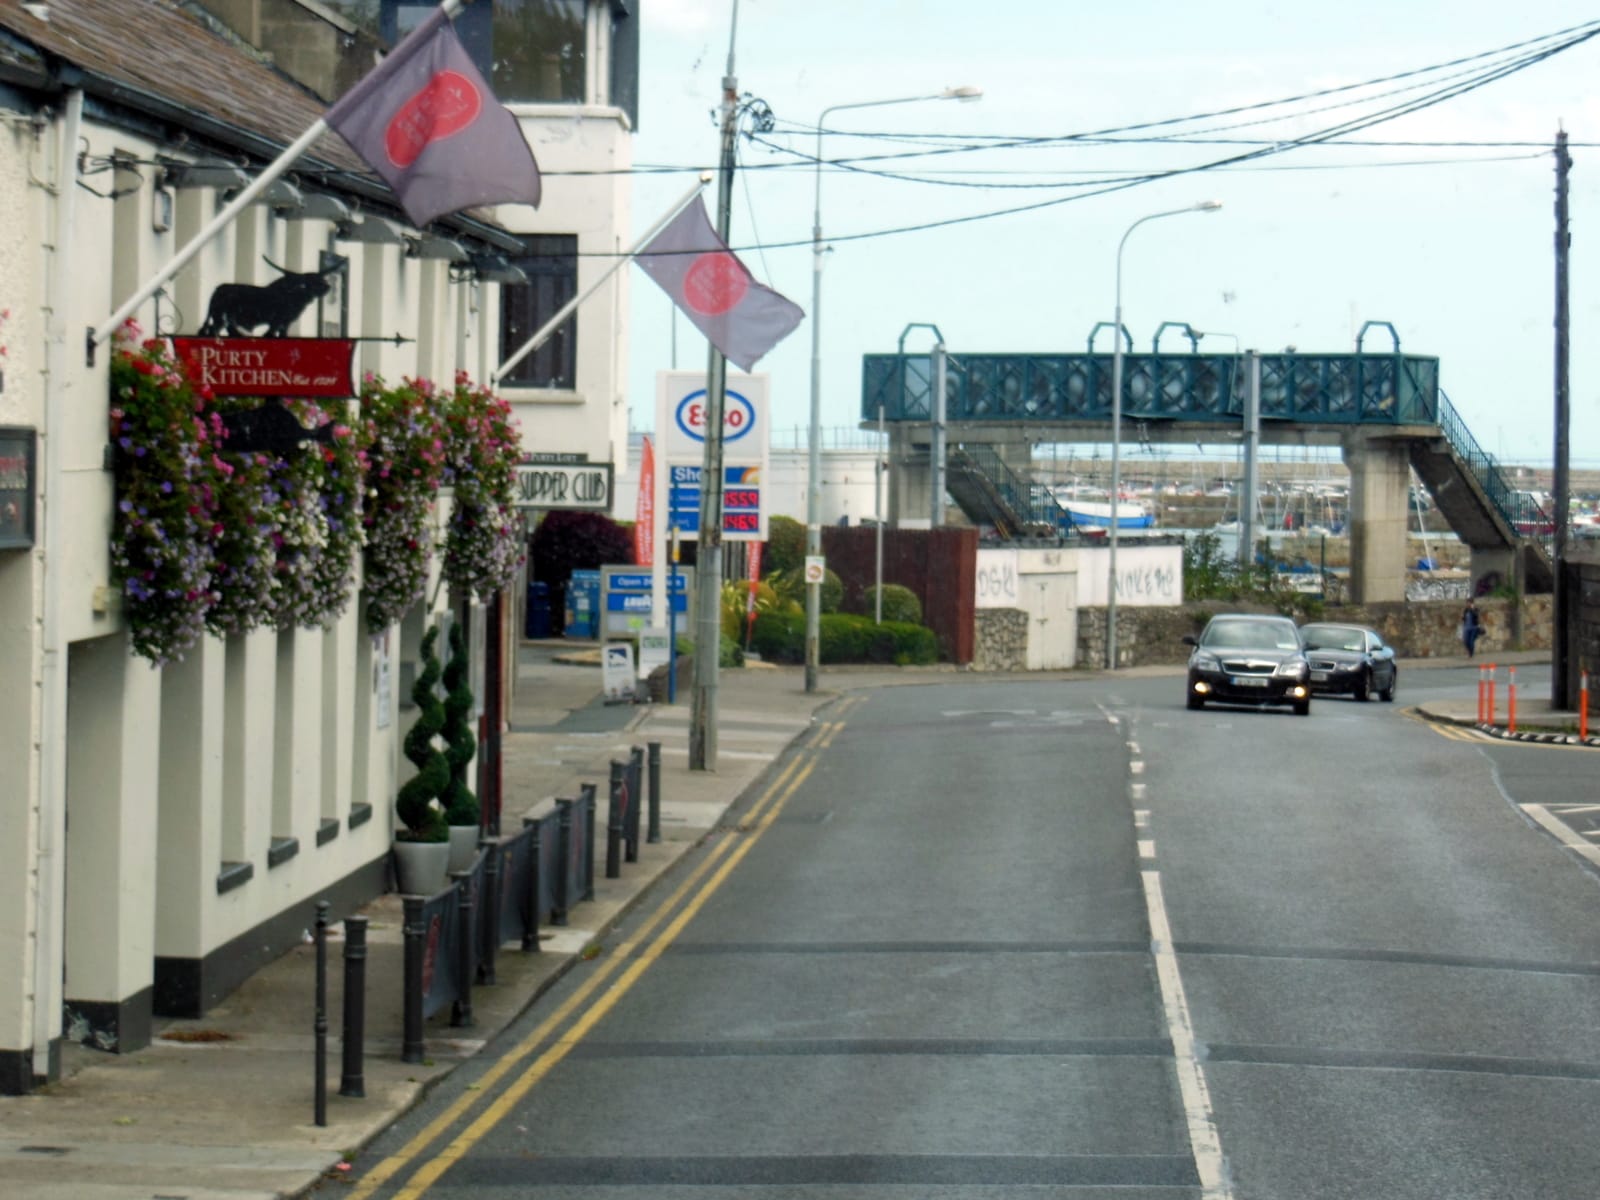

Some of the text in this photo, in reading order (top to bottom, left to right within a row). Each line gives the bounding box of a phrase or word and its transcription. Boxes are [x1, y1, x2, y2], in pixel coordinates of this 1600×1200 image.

[201, 347, 268, 366] PURTY
[201, 366, 293, 385] KITCHEN
[688, 404, 744, 428] Eo
[674, 467, 702, 482] Sho
[518, 471, 606, 502] SUPPER CLUB
